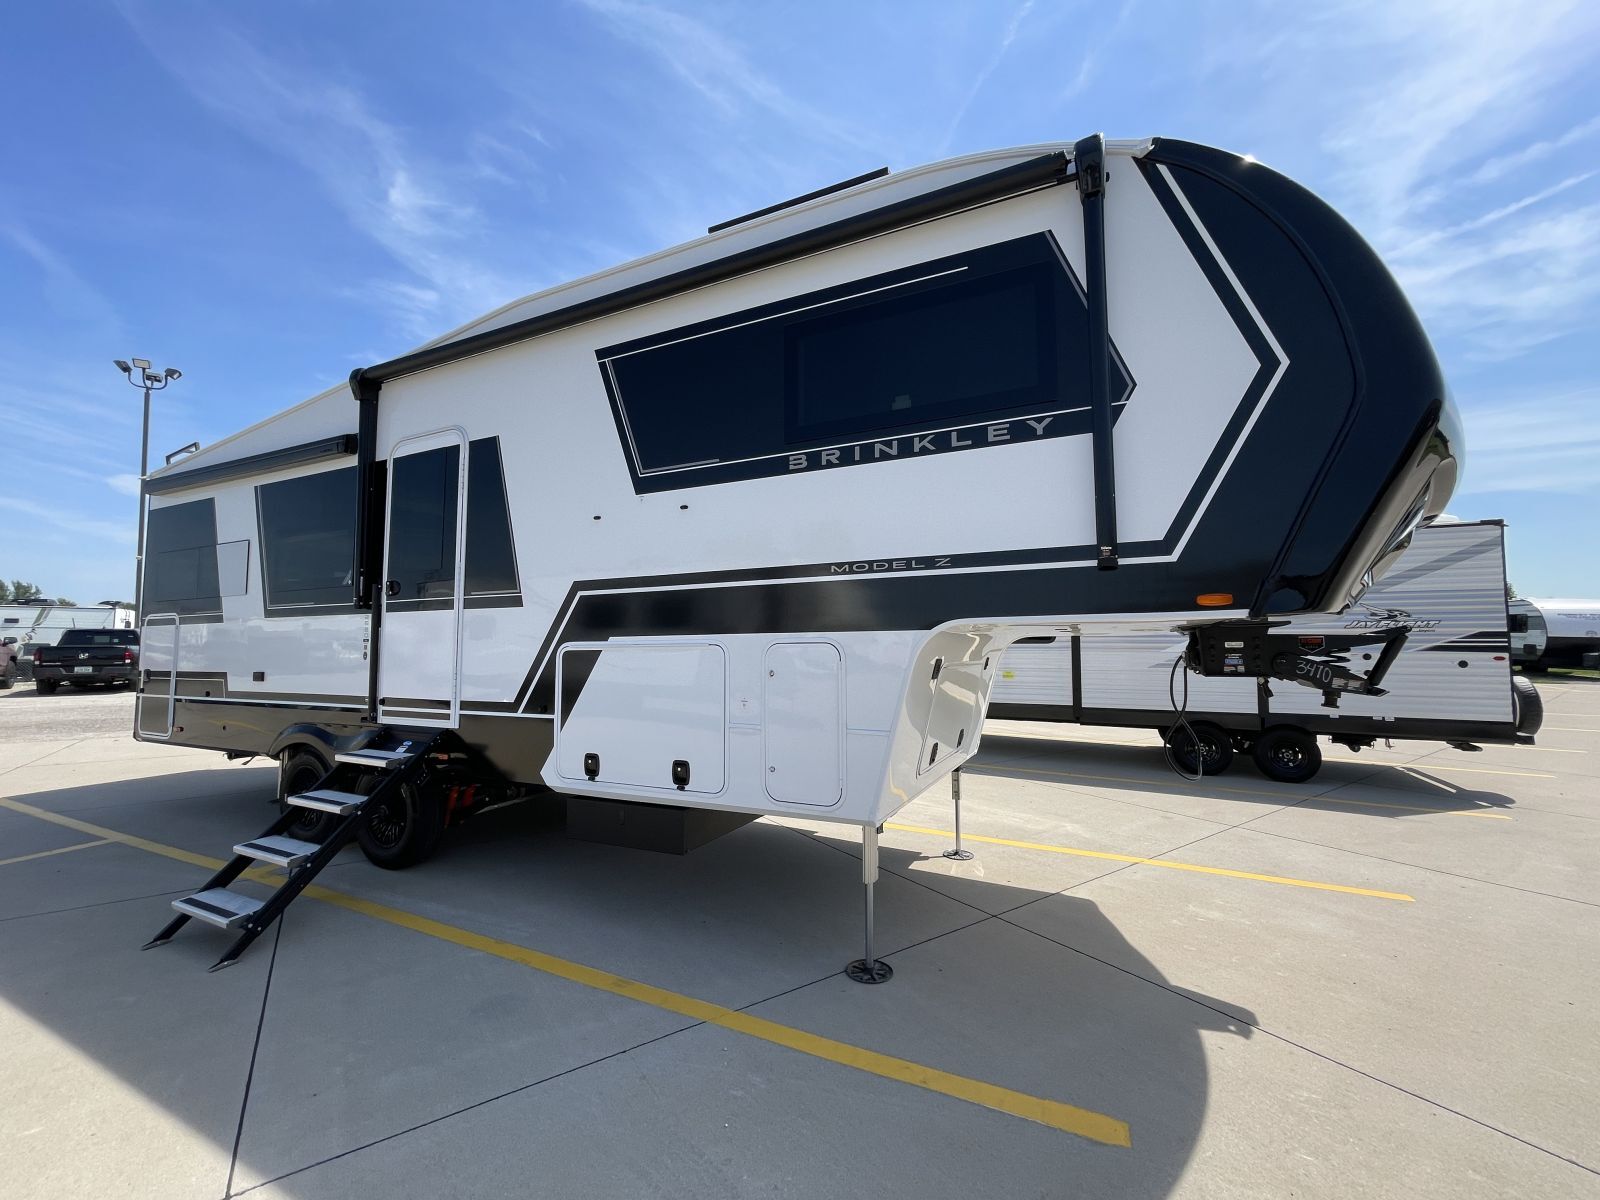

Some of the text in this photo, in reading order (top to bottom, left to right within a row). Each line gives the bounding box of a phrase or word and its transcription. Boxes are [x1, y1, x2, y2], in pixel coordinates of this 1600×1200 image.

[789, 417, 1054, 470] BRINKLEY
[831, 558, 951, 573] MODEL Z
[1344, 620, 1377, 629] JAY
